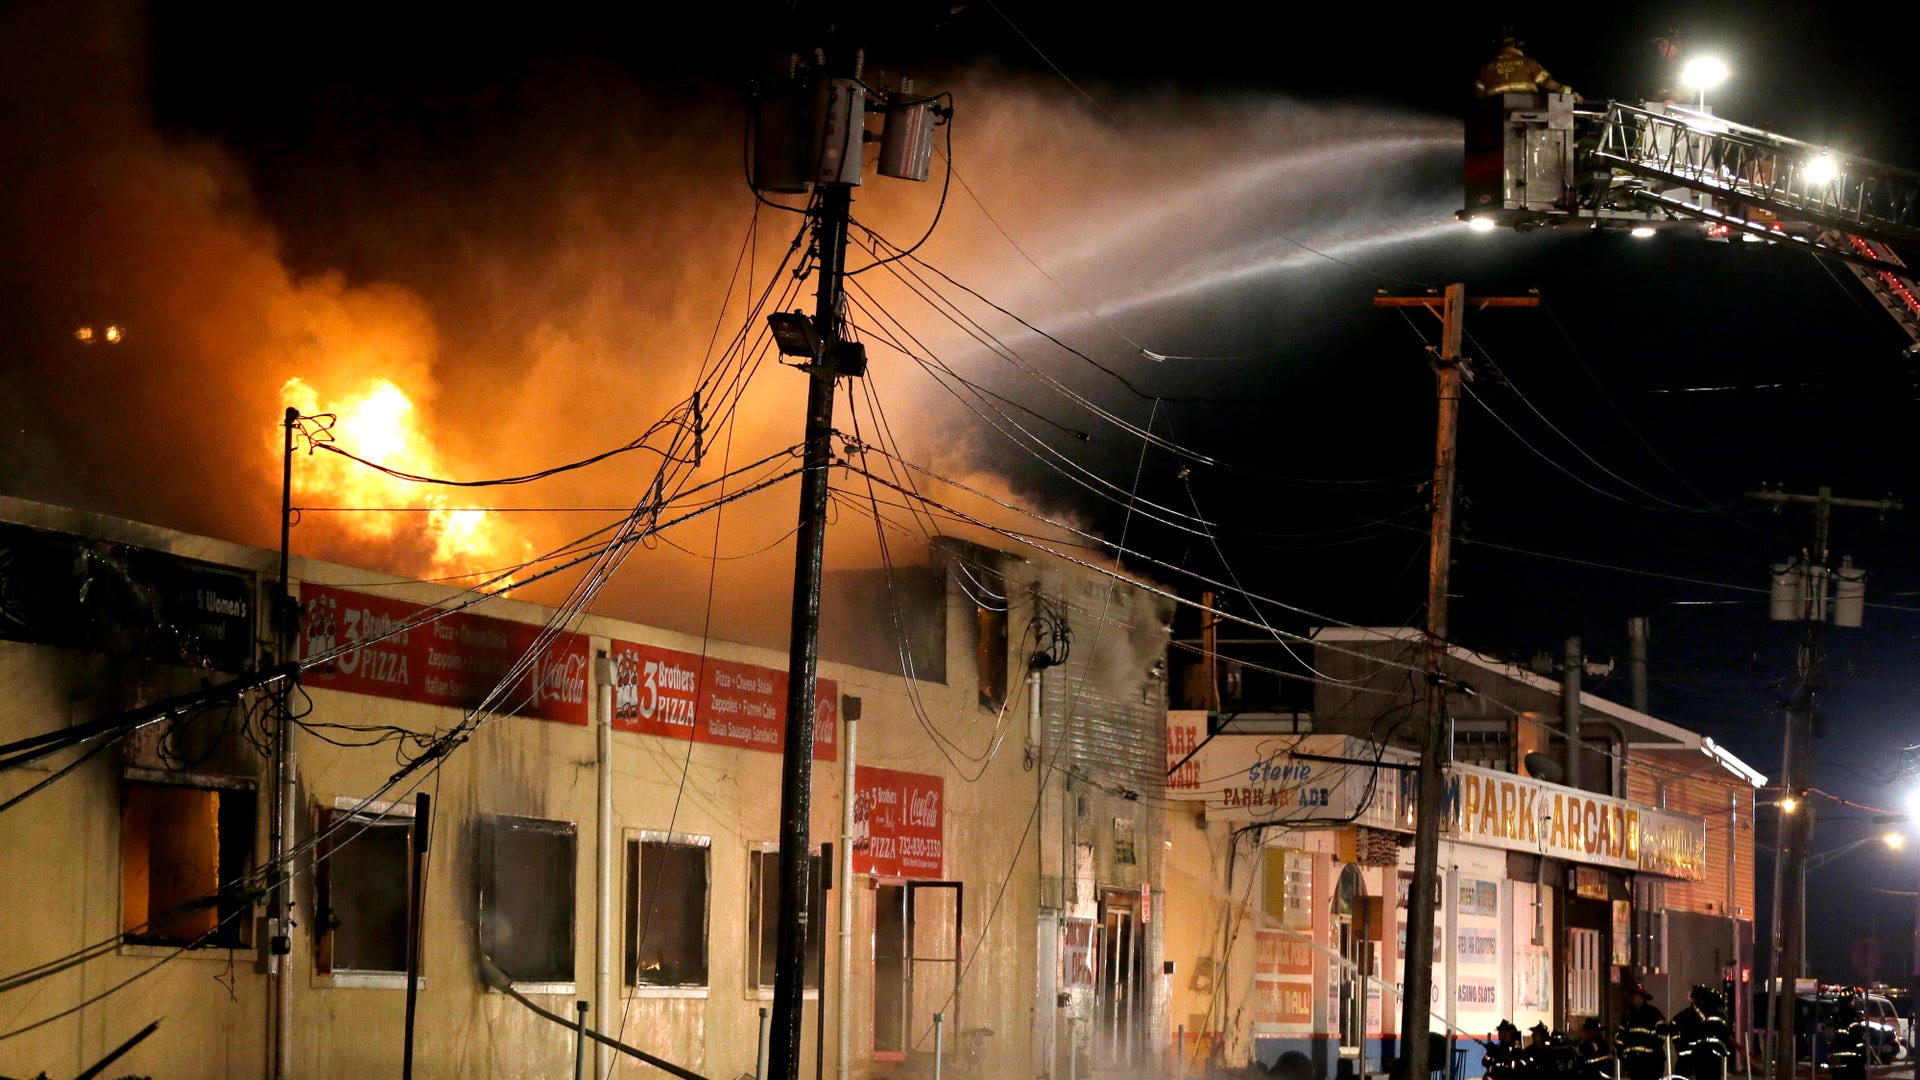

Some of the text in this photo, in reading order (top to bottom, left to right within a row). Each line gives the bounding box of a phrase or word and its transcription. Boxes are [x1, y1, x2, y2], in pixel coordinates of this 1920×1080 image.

[206, 590, 247, 618] Women's
[338, 607, 361, 675] 3
[361, 648, 409, 685] PIZZA
[715, 670, 731, 688] Pizza
[736, 673, 757, 692] Cheese
[639, 659, 695, 719] 3 Brothers
[656, 695, 695, 727] PIZZA
[711, 694, 738, 714] Zeppoles
[762, 703, 776, 720] Cake
[727, 721, 752, 743] Sausage
[1166, 760, 1201, 790] CADE
[870, 787, 877, 809] 3
[910, 788, 939, 828] Coca-Cola
[1223, 787, 1329, 807] PARK ARADE
[1464, 773, 1538, 844] PARK
[1549, 793, 1638, 862] ARCADE
[870, 836, 896, 859] PIZZA
[1477, 985, 1496, 1003] SLOTS
